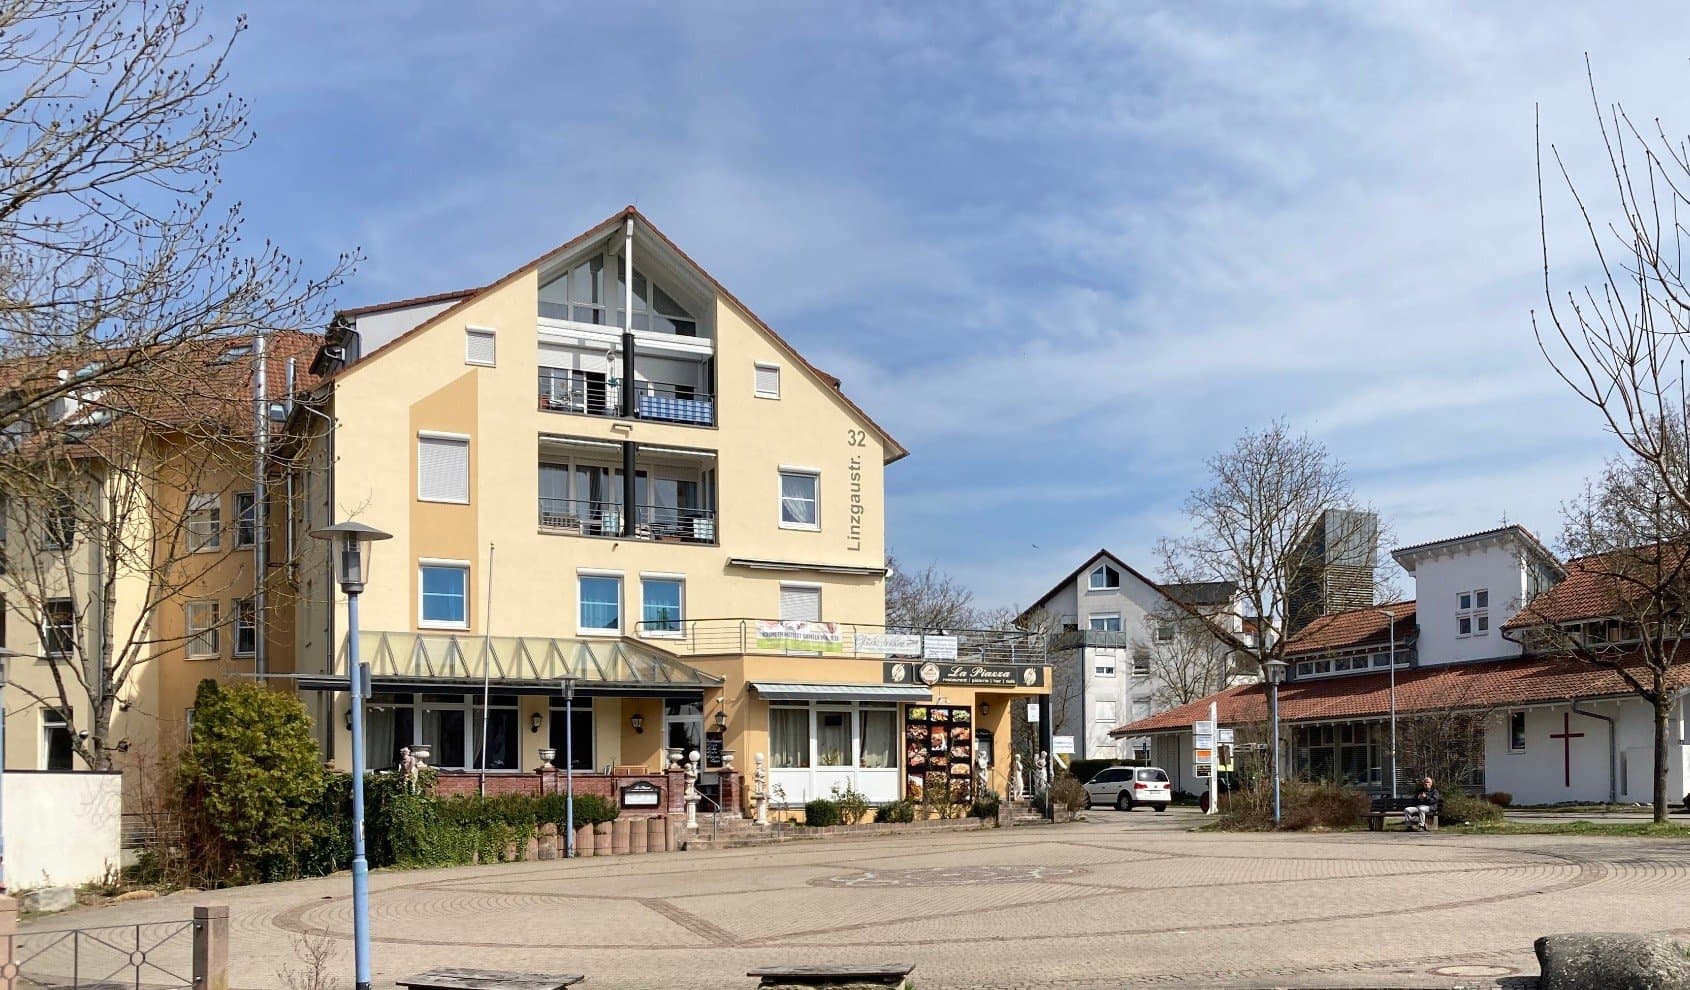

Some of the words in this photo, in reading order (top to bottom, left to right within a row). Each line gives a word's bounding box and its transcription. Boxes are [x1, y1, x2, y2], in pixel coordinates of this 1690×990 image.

[848, 429, 866, 447] 32
[847, 455, 864, 551] Linzgaustr.
[948, 666, 968, 677] La
[970, 666, 1011, 678] Piazza
